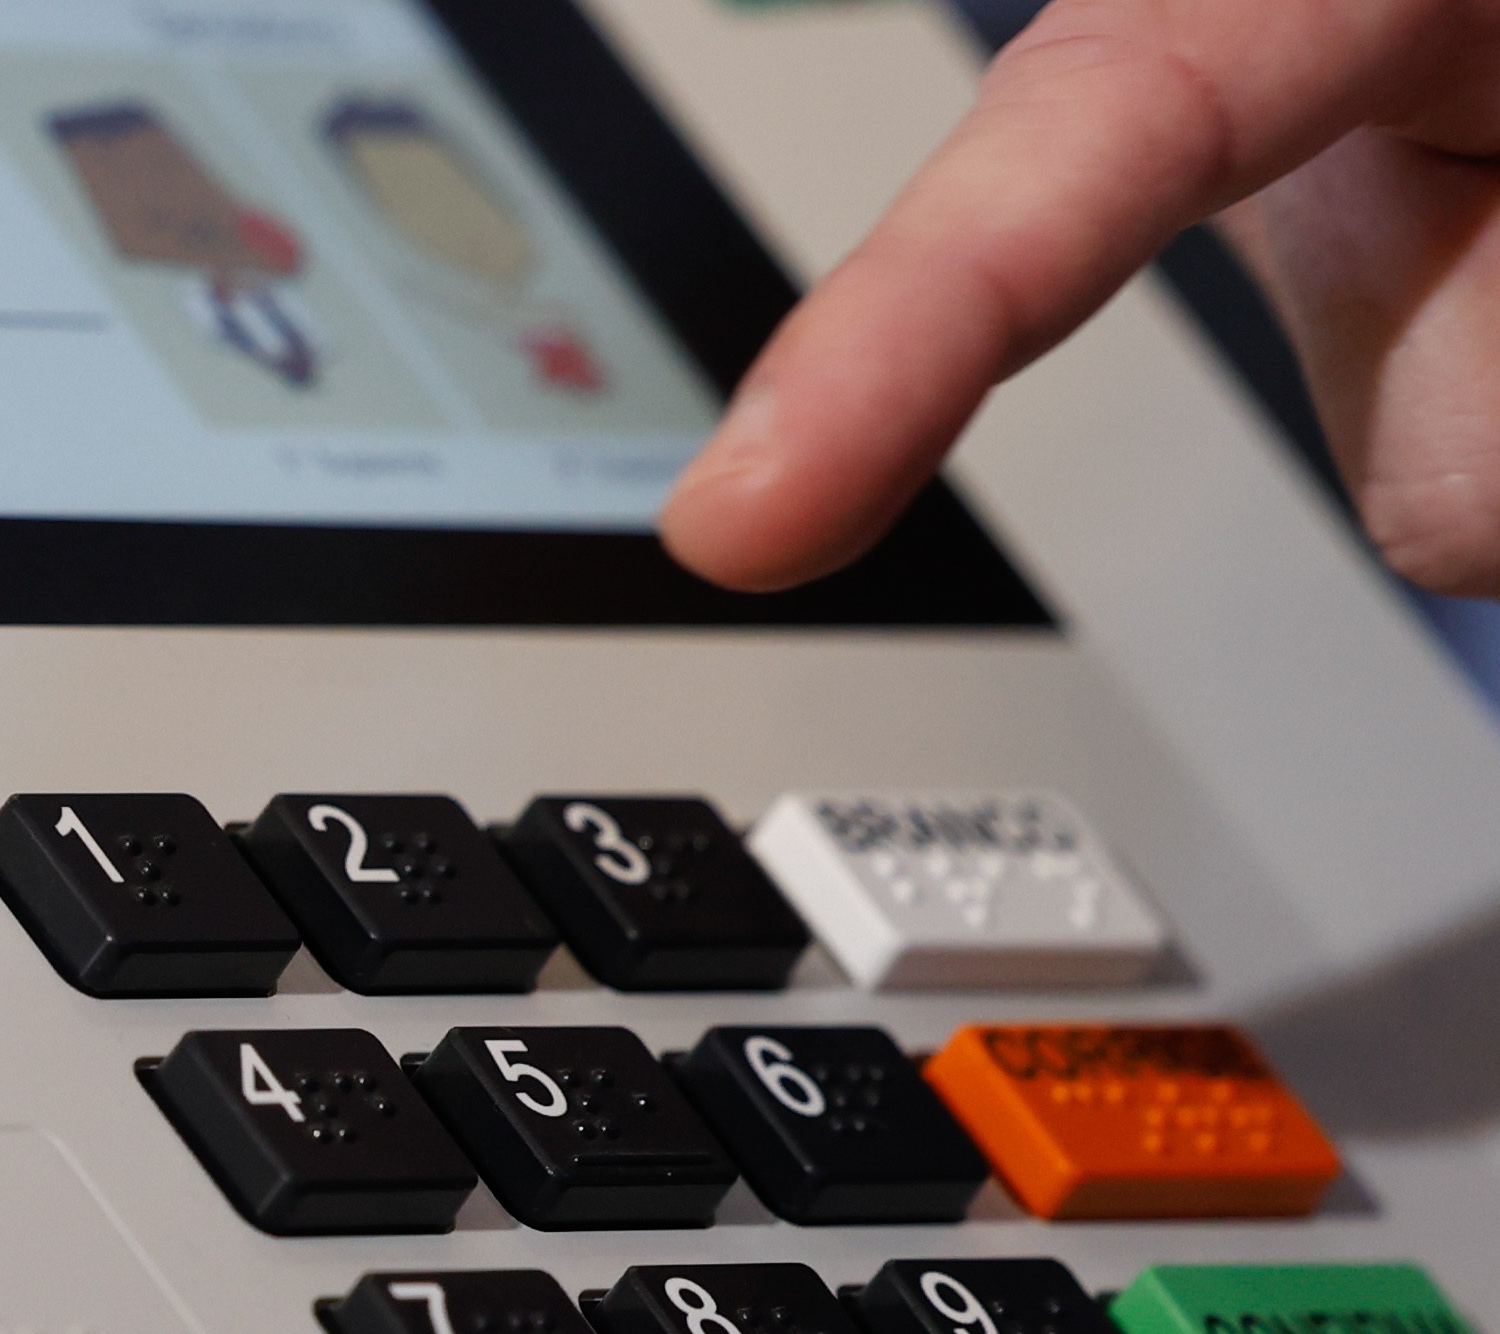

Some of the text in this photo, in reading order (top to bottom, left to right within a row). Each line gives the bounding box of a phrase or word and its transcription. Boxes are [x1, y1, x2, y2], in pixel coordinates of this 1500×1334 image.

[54, 806, 125, 884] 1
[307, 804, 400, 884] 2
[562, 802, 650, 887] 3
[239, 1042, 306, 1123] 4
[484, 1039, 568, 1117] 5
[744, 1035, 825, 1116] 6
